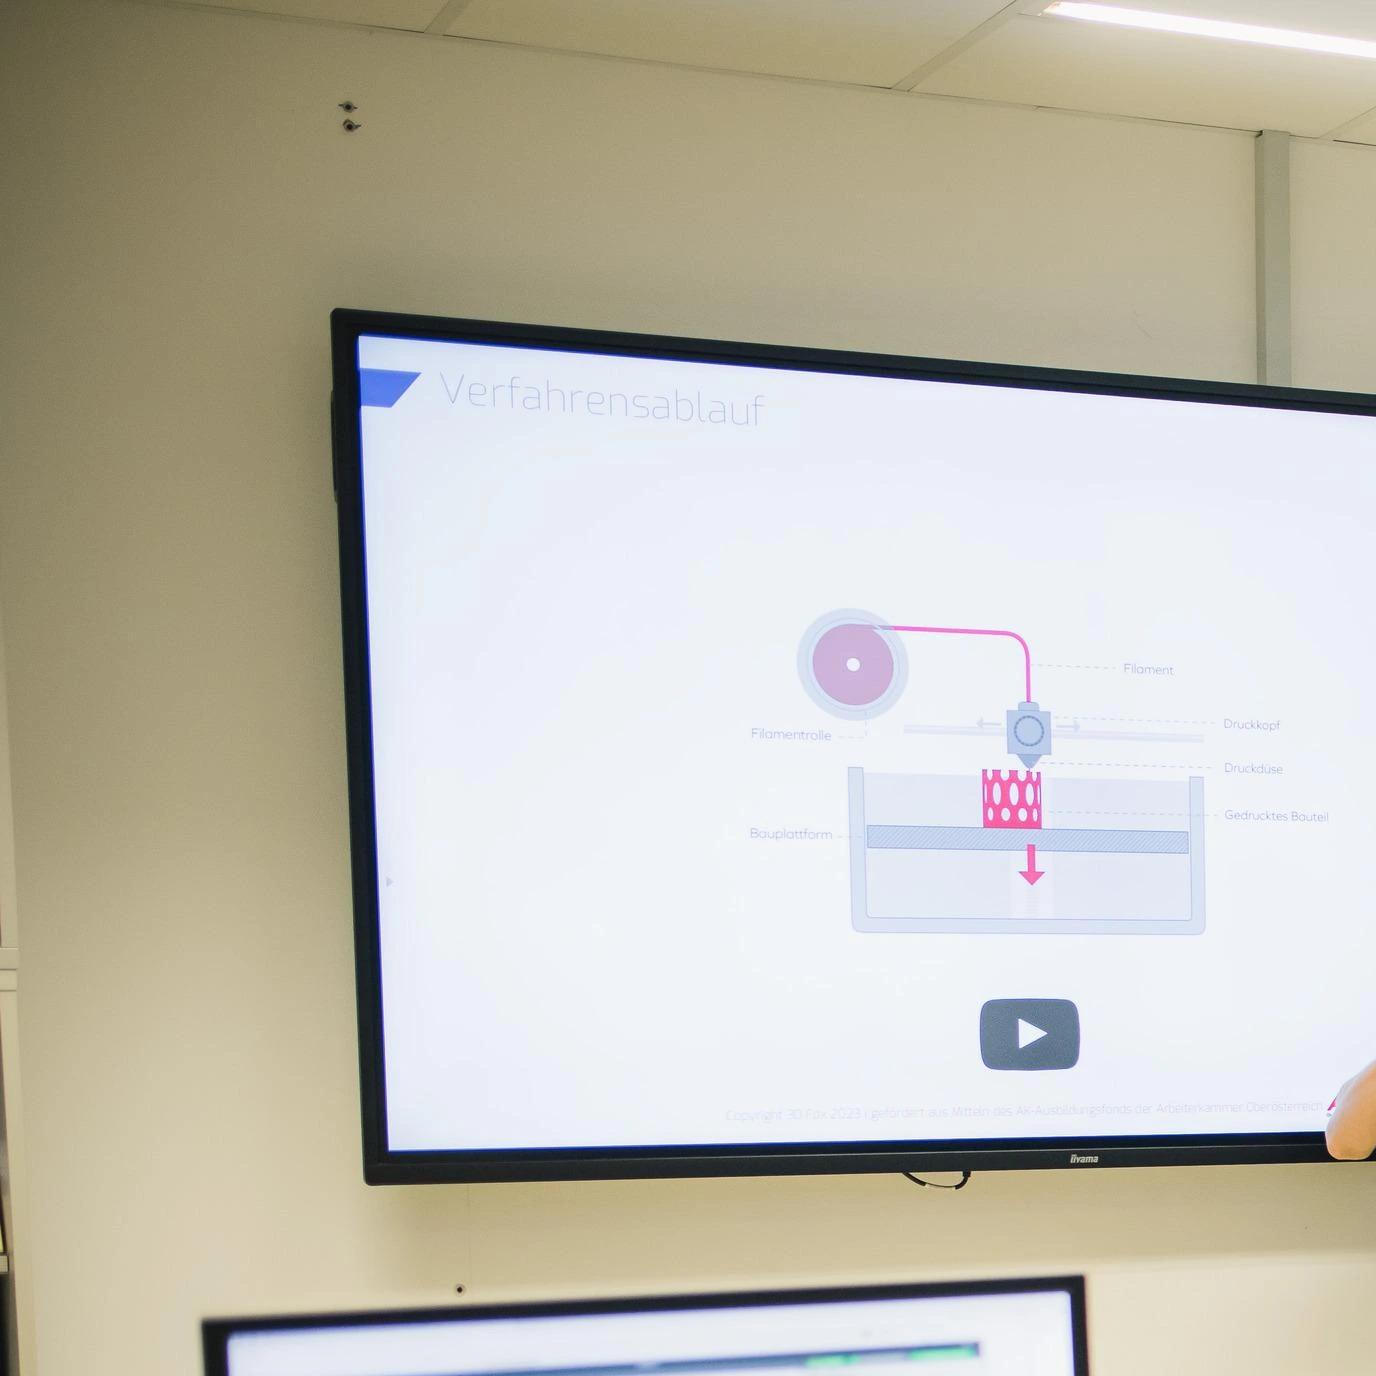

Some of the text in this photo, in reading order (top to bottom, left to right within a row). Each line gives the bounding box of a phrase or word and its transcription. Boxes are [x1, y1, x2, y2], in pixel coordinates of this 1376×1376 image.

[439, 370, 766, 428] Verfahrensablauf
[1123, 661, 1175, 677] Filament
[1223, 718, 1281, 732] Druckkopf
[750, 727, 833, 742] Filamentrolle
[1224, 809, 1329, 823] Gedrucktes Bauteil
[749, 827, 833, 842] Bauplattform
[830, 1106, 861, 1120] 2023
